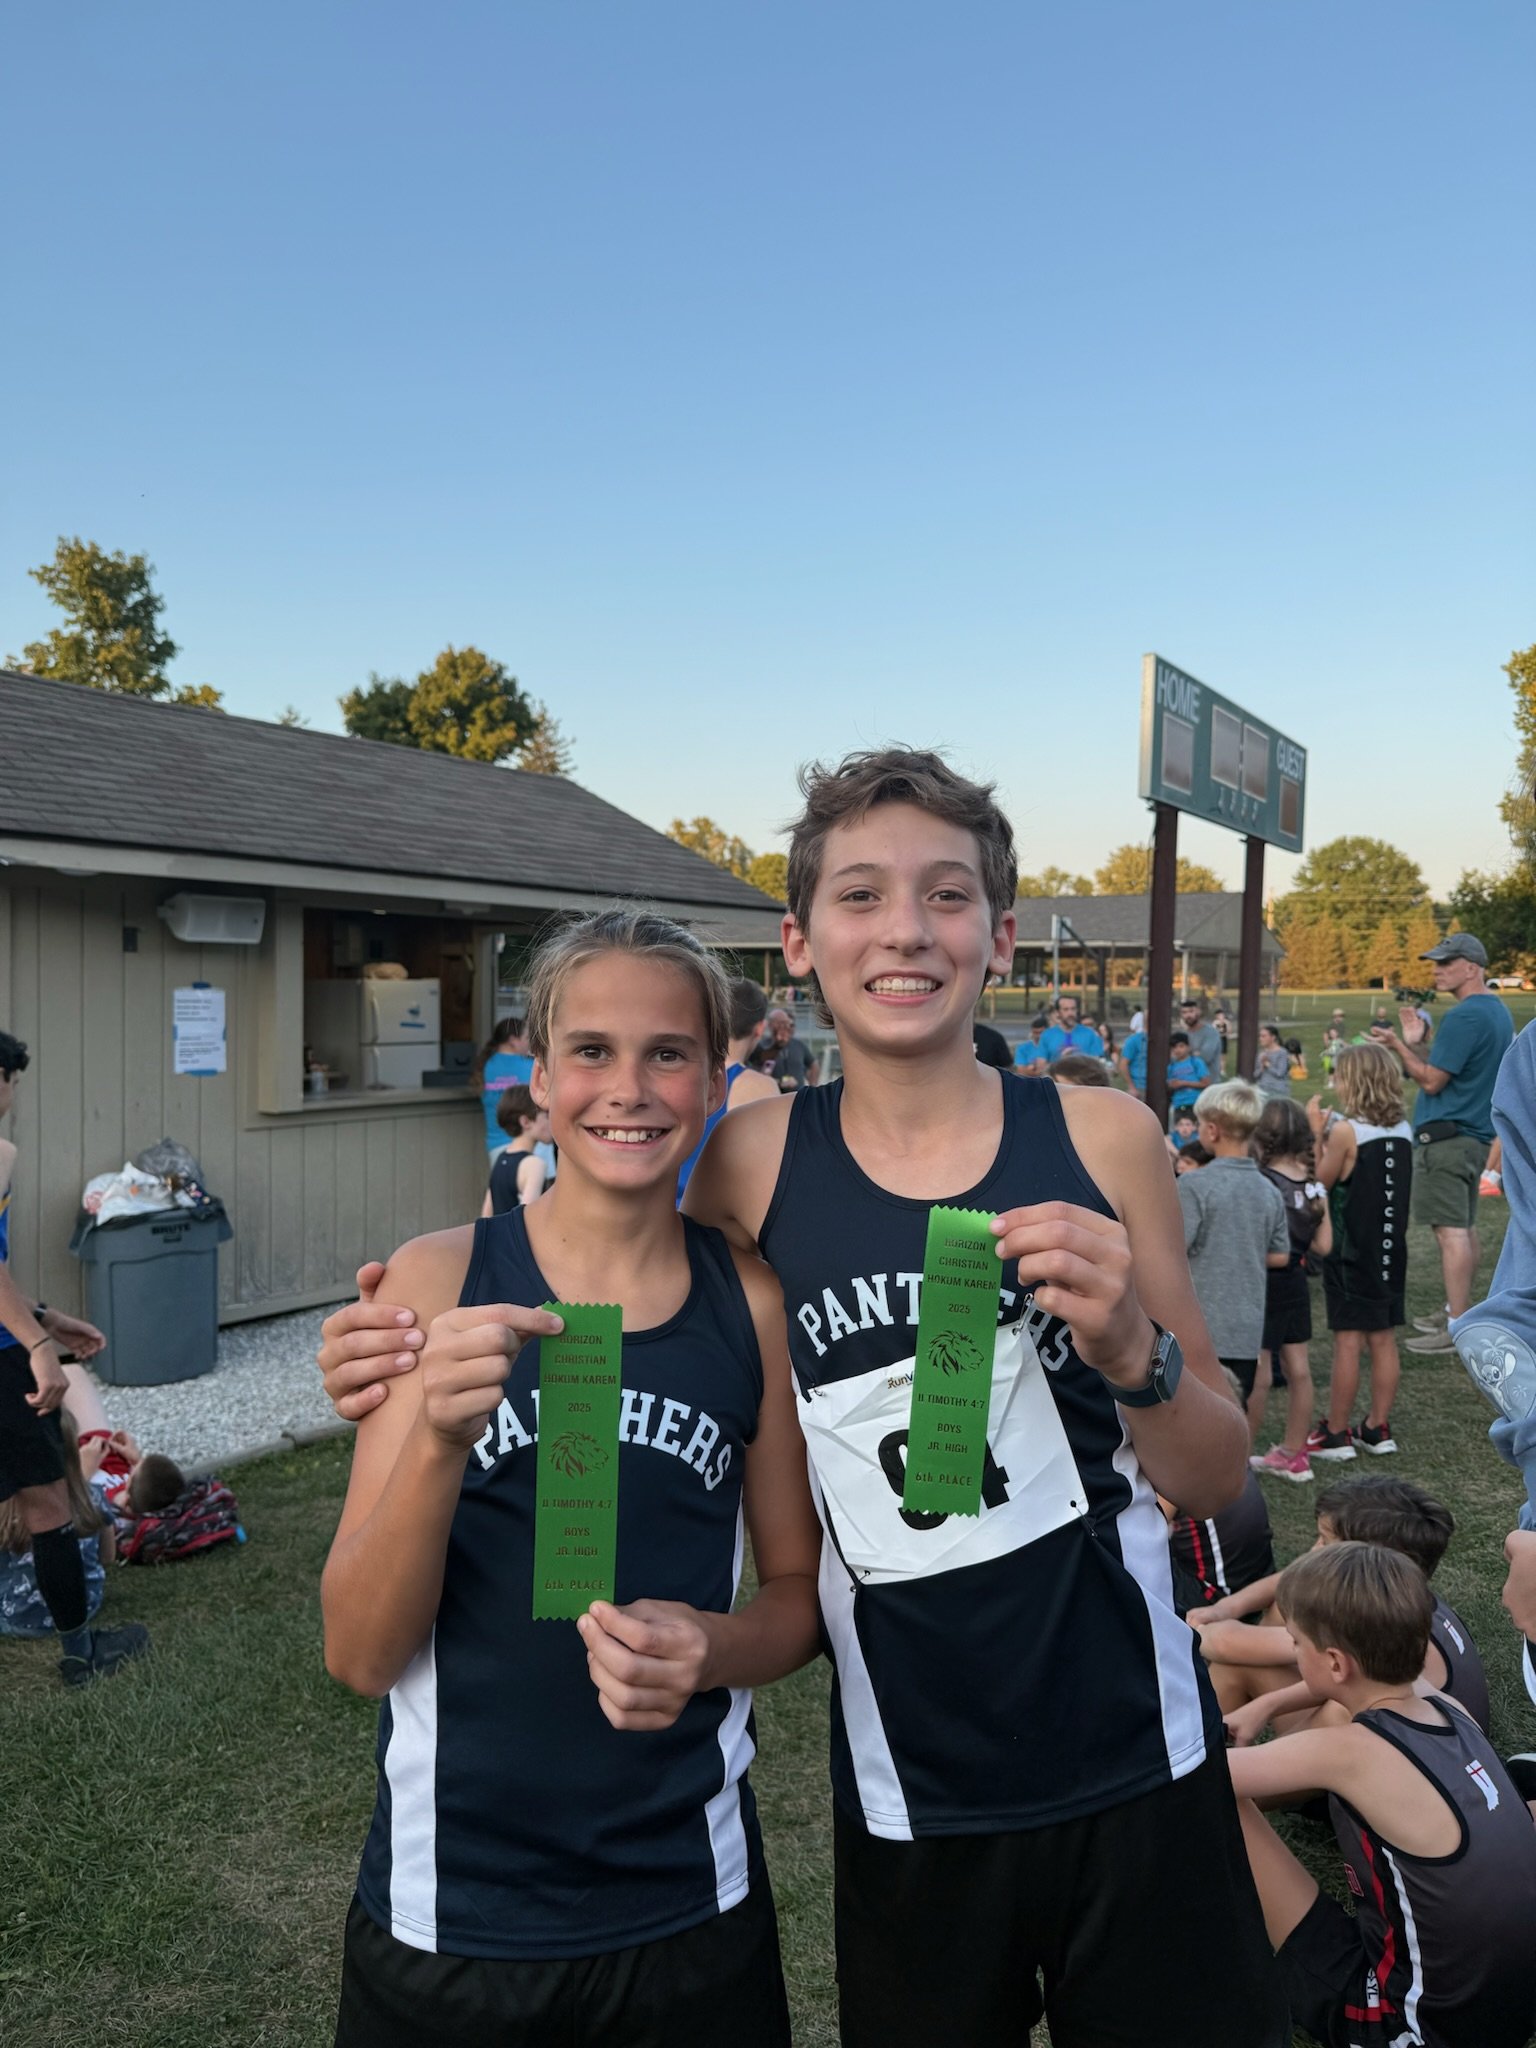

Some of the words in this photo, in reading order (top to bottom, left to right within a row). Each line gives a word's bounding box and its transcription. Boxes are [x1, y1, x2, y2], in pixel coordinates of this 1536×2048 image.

[1157, 664, 1200, 724] HOME
[1276, 738, 1305, 781] GUEST
[944, 1238, 986, 1251] HORIZON
[939, 1256, 989, 1270] CHRISTIAN
[927, 1274, 961, 1286] HOKUM
[964, 1278, 997, 1290] KAREM
[948, 1303, 971, 1314] 2025
[560, 1334, 603, 1345] HORIZON
[554, 1354, 607, 1365] CHRISTIAN
[544, 1374, 580, 1384] HOKUM
[582, 1375, 617, 1385] KAREM
[928, 1394, 968, 1407] TIMOTHY
[970, 1400, 985, 1409] 4:7
[567, 1402, 592, 1413] 2025
[937, 1423, 962, 1433] BOYS
[945, 1443, 968, 1453] HIGH
[915, 1472, 933, 1482] 6th
[939, 1474, 973, 1486] PLACE
[552, 1499, 594, 1509] TIMOTHY
[597, 1500, 612, 1509] 4:7
[564, 1527, 590, 1537] BOYS
[574, 1547, 598, 1556] HIGH
[545, 1580, 564, 1590] 6th
[570, 1580, 605, 1590] PLACE
